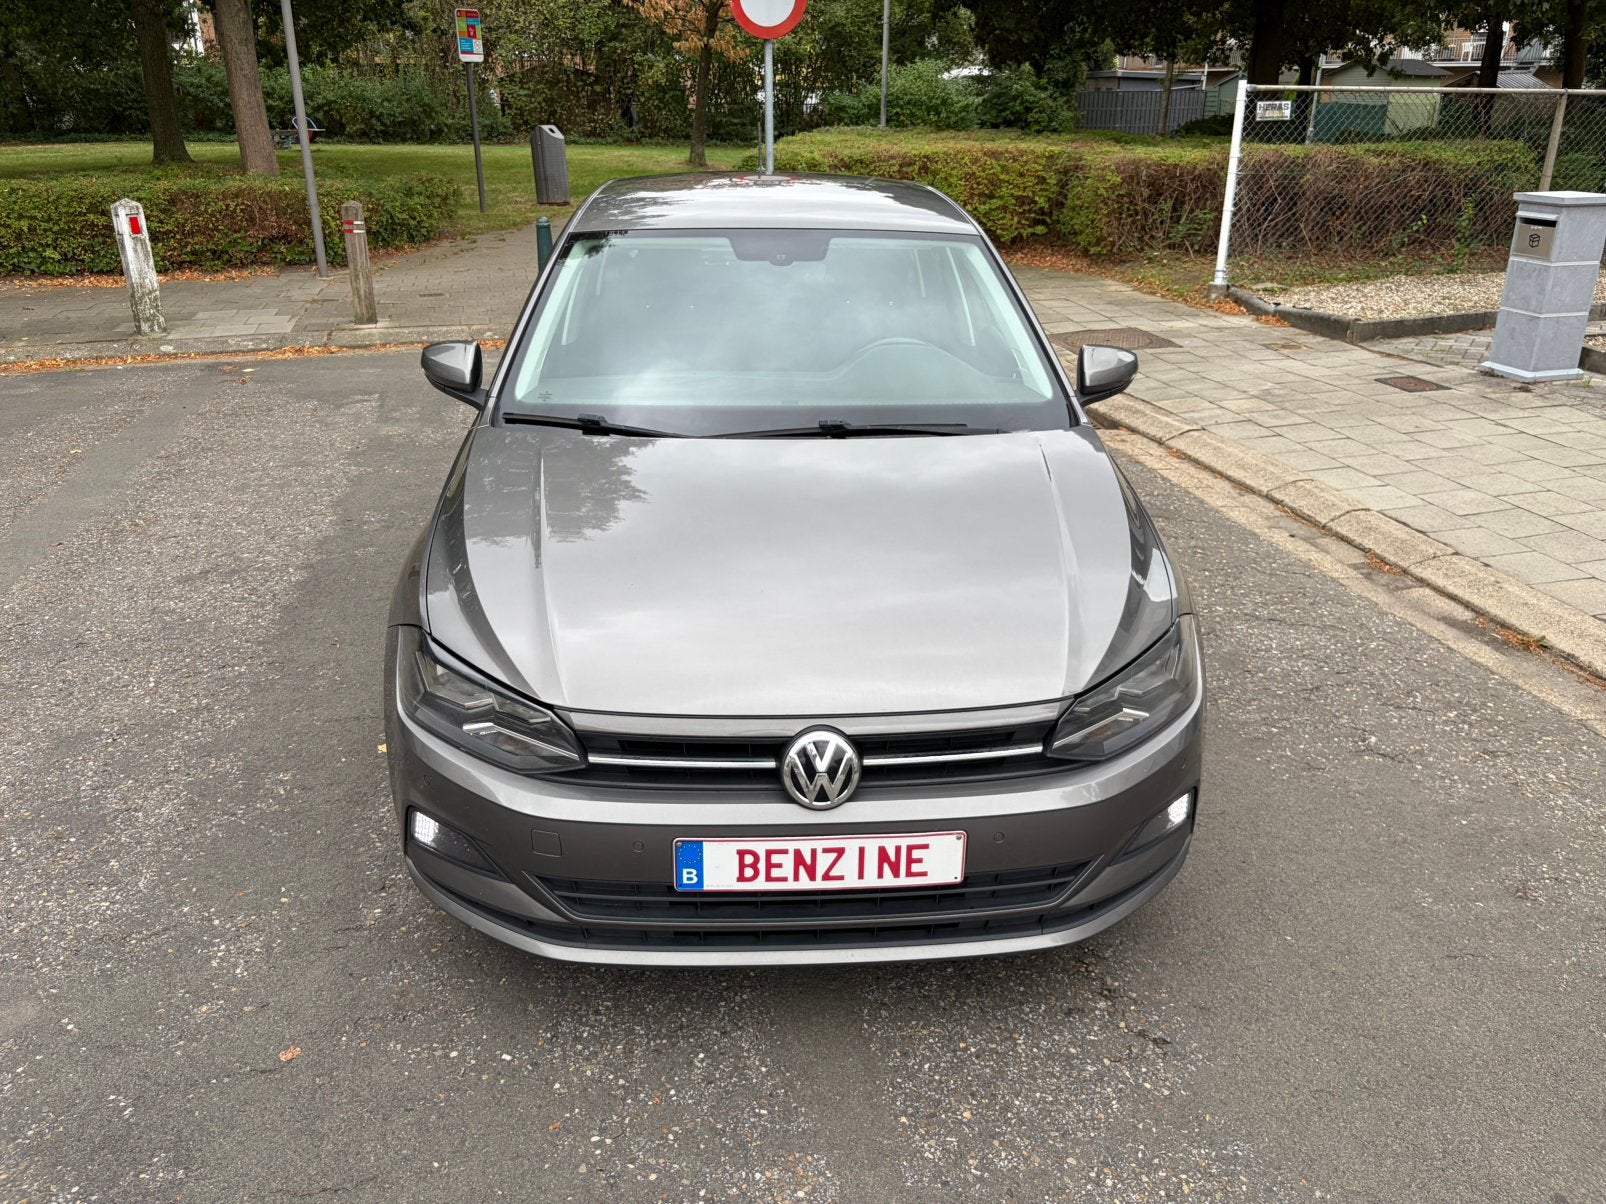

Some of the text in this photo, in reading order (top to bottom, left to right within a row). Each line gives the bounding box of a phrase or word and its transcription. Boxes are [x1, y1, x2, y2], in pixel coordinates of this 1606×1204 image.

[1258, 103, 1290, 111] HERAS
[736, 843, 930, 883] BENZINE
[682, 868, 698, 884] B
